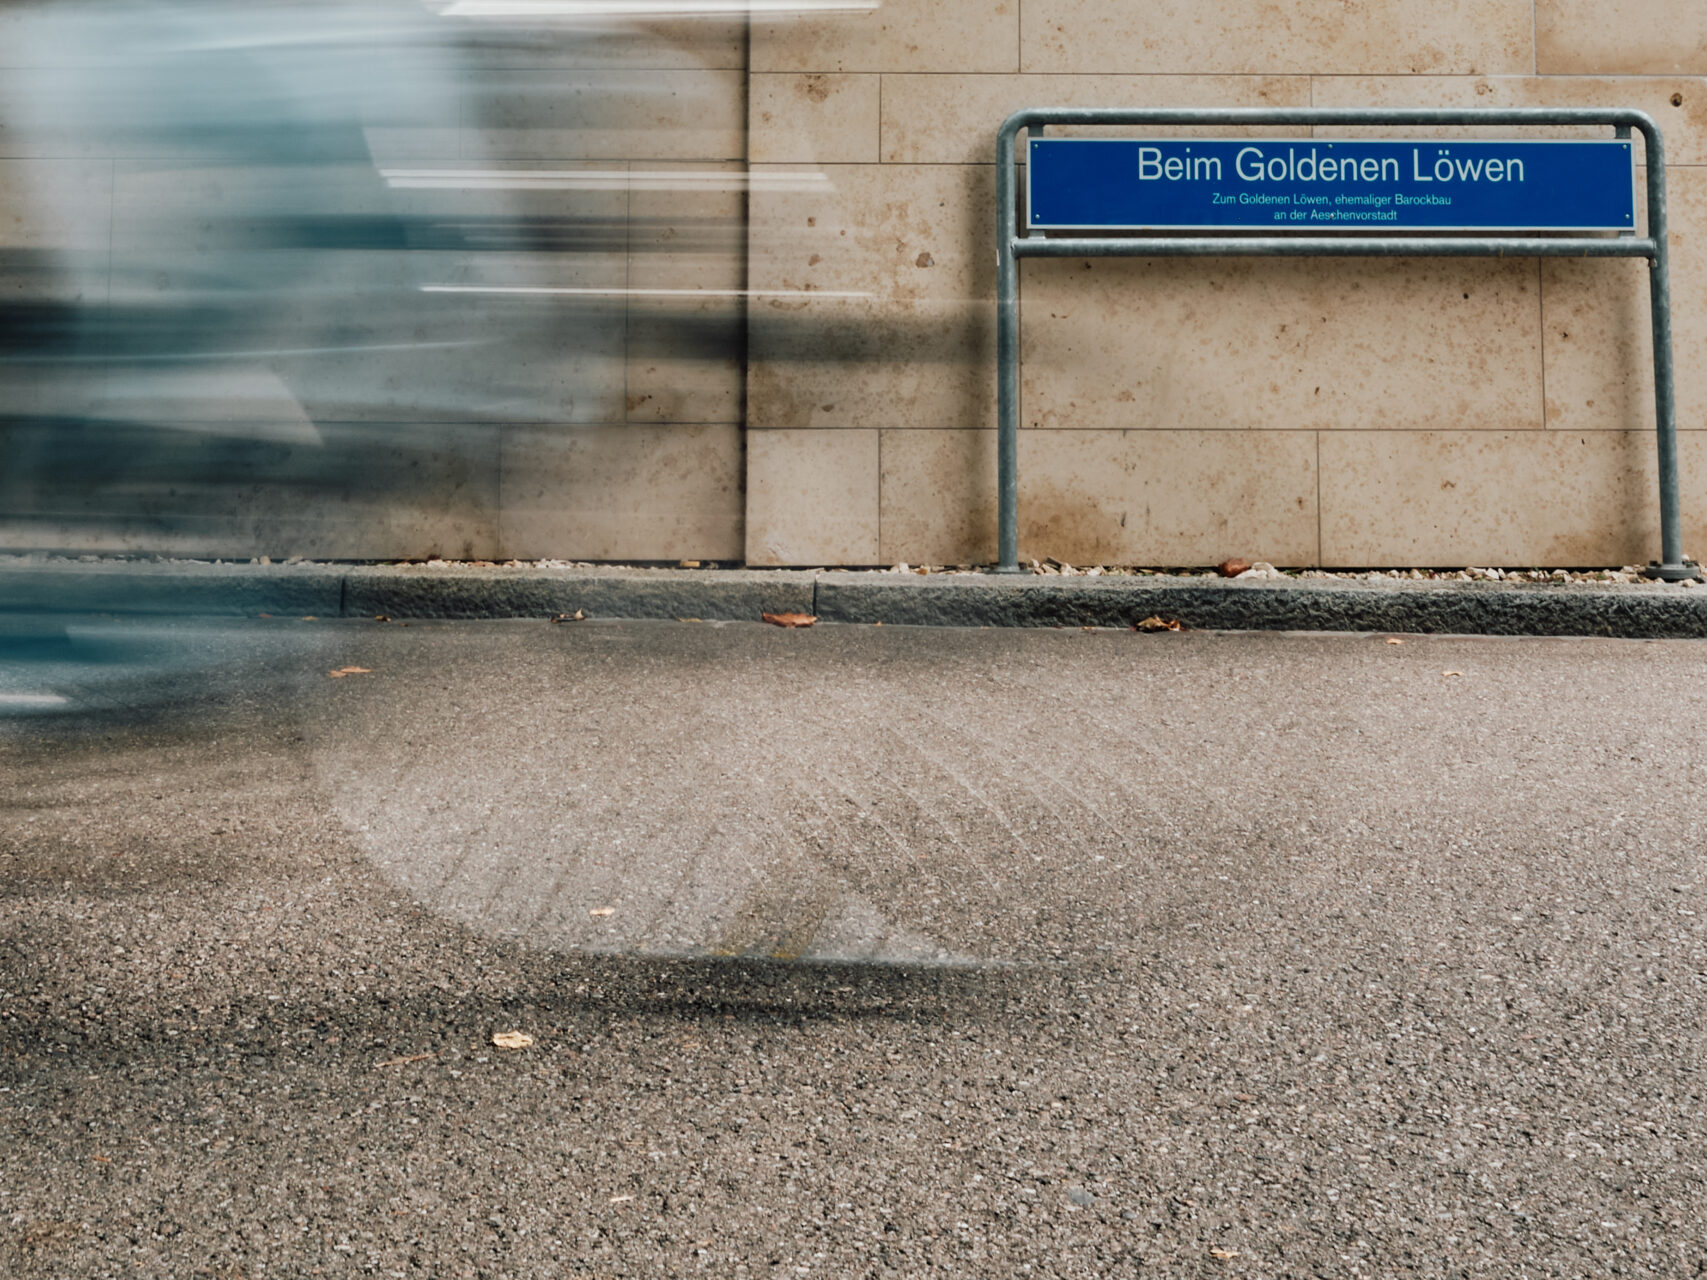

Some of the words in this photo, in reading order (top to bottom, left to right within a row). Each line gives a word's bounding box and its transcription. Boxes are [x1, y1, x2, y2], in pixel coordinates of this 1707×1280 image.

[1137, 146, 1223, 181] Beim
[1235, 146, 1400, 182] Goldenen
[1412, 147, 1525, 183] Löwen
[1212, 192, 1236, 205] Zum
[1239, 192, 1291, 205] Goldenen
[1293, 193, 1332, 206] Löwen,
[1334, 193, 1392, 208] ehemaliger
[1394, 193, 1451, 206] Barockbau
[1273, 210, 1287, 220] an
[1289, 209, 1308, 220] der
[1310, 208, 1398, 221] Aeschenvorstadt
